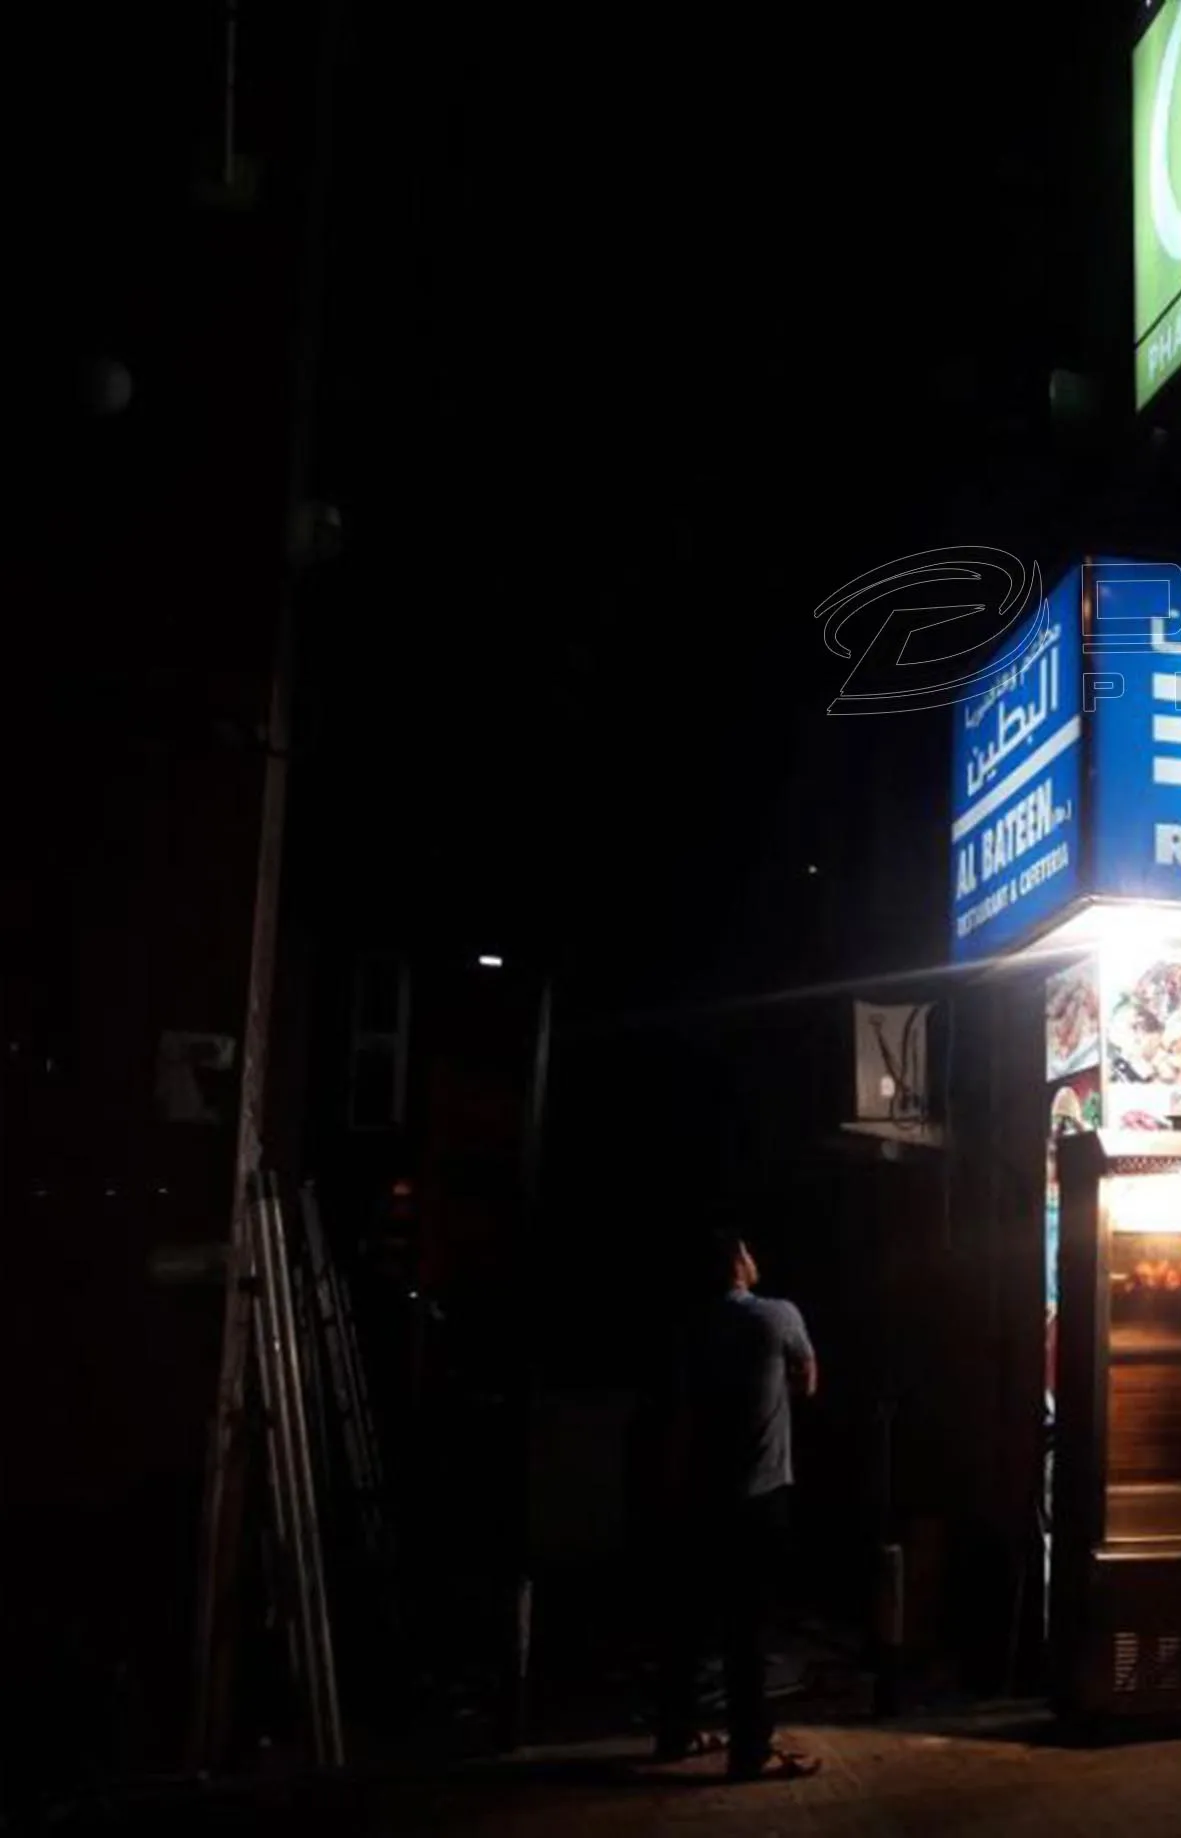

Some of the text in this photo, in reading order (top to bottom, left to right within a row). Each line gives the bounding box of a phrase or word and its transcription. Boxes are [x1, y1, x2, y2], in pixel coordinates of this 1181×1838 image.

[967, 647, 1059, 798] البطين
[956, 777, 1053, 901] AL BATEEN
